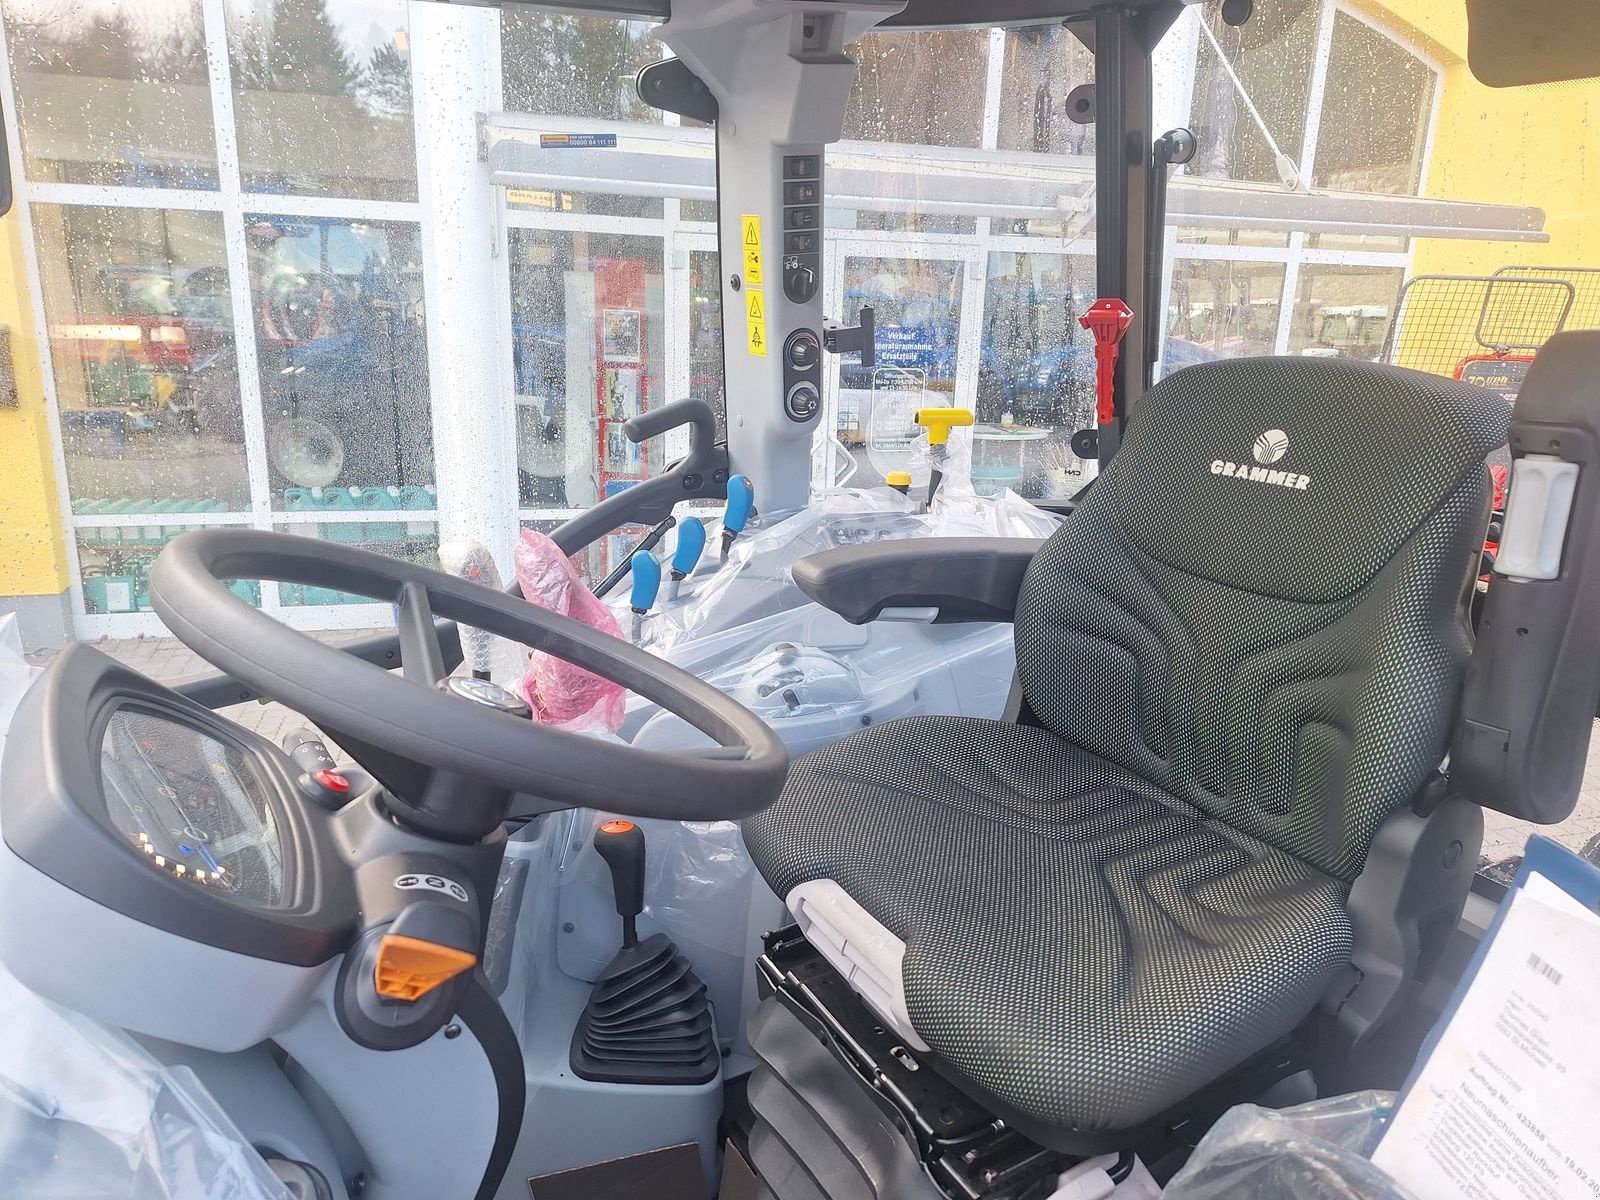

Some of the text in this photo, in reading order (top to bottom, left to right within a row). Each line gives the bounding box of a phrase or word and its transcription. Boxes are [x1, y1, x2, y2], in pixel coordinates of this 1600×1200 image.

[888, 331, 916, 341] Verkauf
[875, 342, 933, 352] paraturannahme
[881, 352, 918, 362] Ersatzteile
[1210, 460, 1311, 490] GRAMMER
[1469, 1066, 1497, 1098] Auftrag
[1516, 1111, 1546, 1142] 423858
